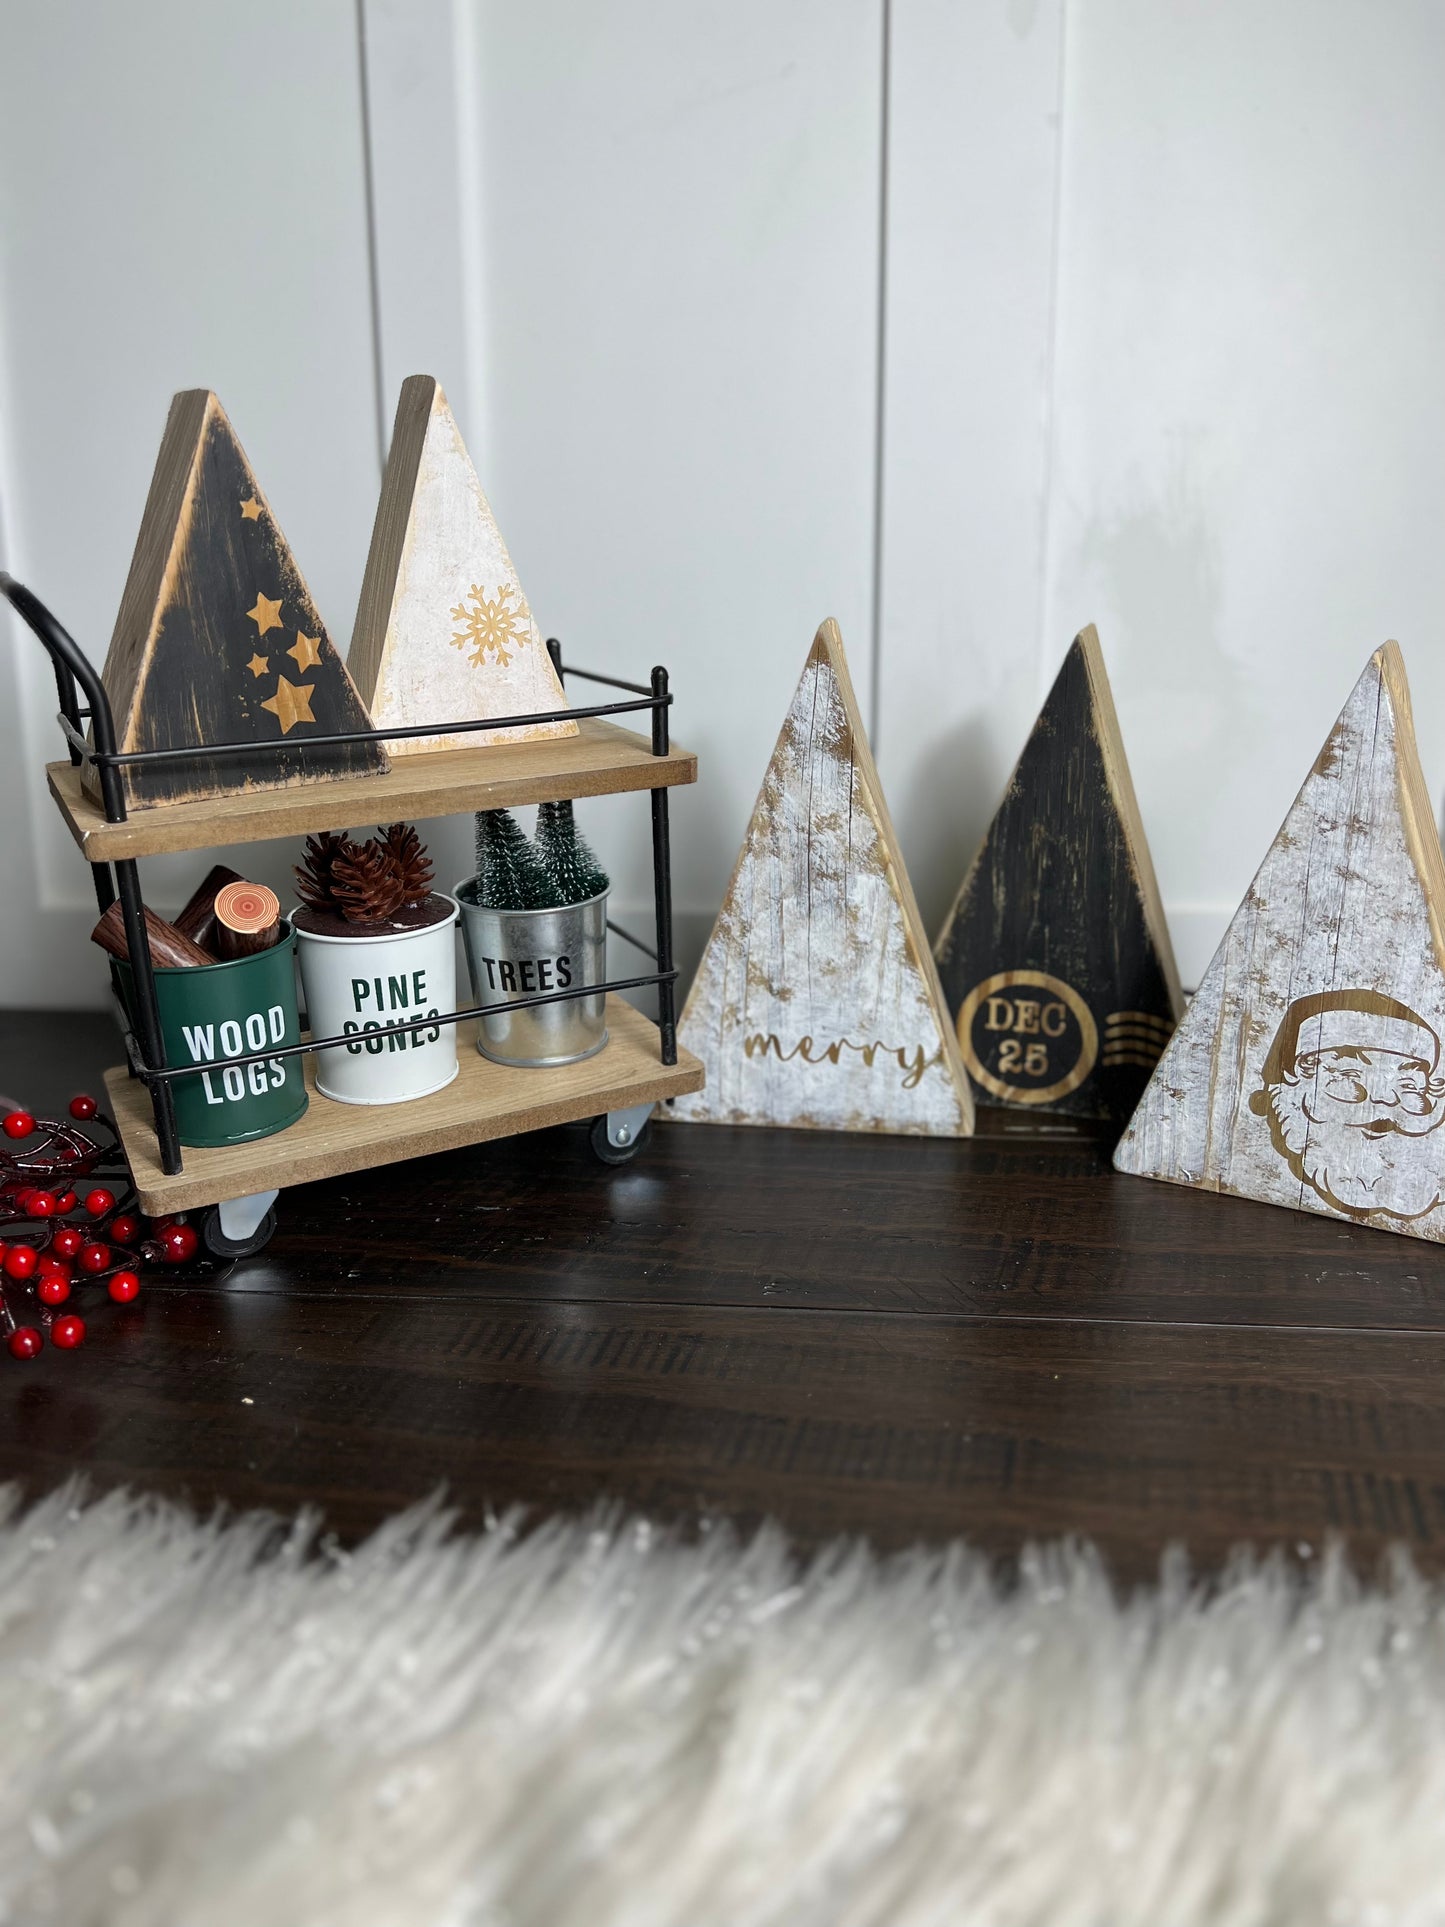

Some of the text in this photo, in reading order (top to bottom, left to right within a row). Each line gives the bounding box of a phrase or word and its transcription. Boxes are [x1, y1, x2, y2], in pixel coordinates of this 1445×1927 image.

[351, 969, 428, 1013] PINE
[482, 956, 572, 992] TREES
[182, 1005, 286, 1062] WOOD
[343, 1008, 441, 1055] CONES
[984, 997, 1067, 1037] DEC
[201, 1057, 286, 1105] LOGS
[744, 1033, 942, 1089] merry
[998, 1040, 1049, 1077] 25
